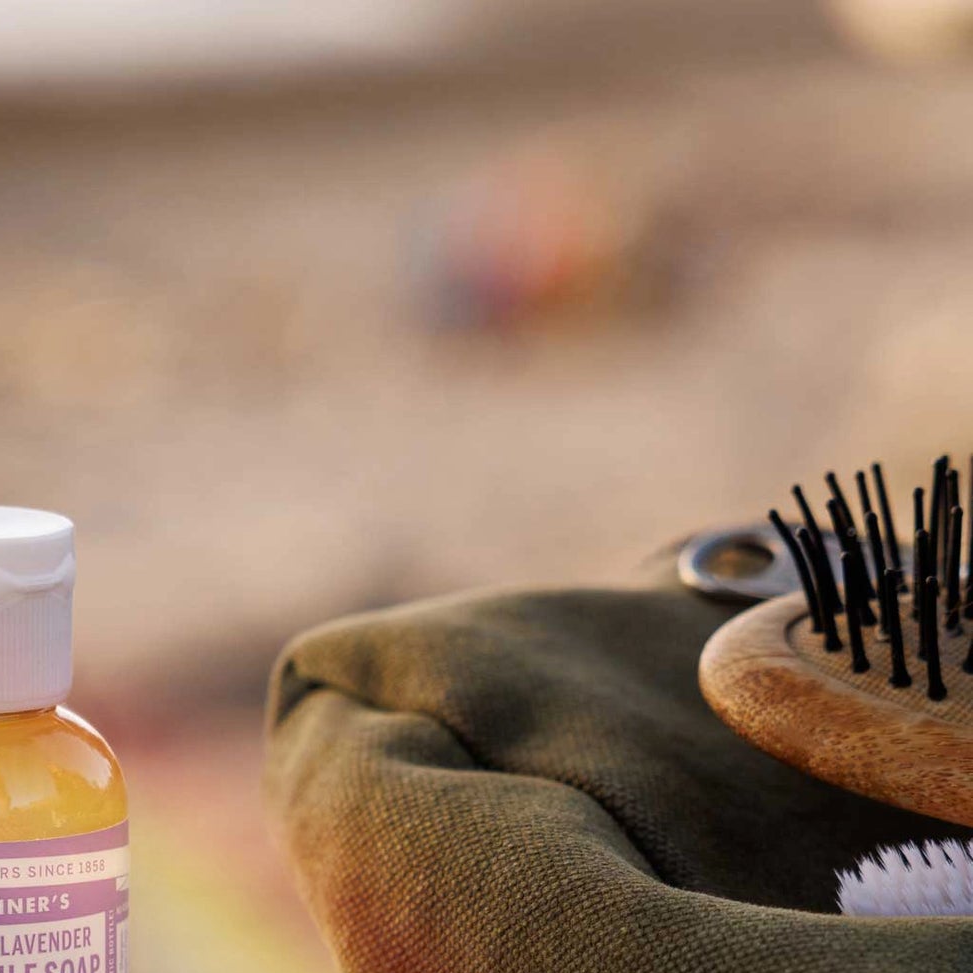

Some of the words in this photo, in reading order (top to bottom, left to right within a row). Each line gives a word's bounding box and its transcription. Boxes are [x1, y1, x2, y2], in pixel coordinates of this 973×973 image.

[28, 863, 74, 878] SINCE
[78, 859, 105, 874] 1858
[0, 926, 91, 956] LAVENDER
